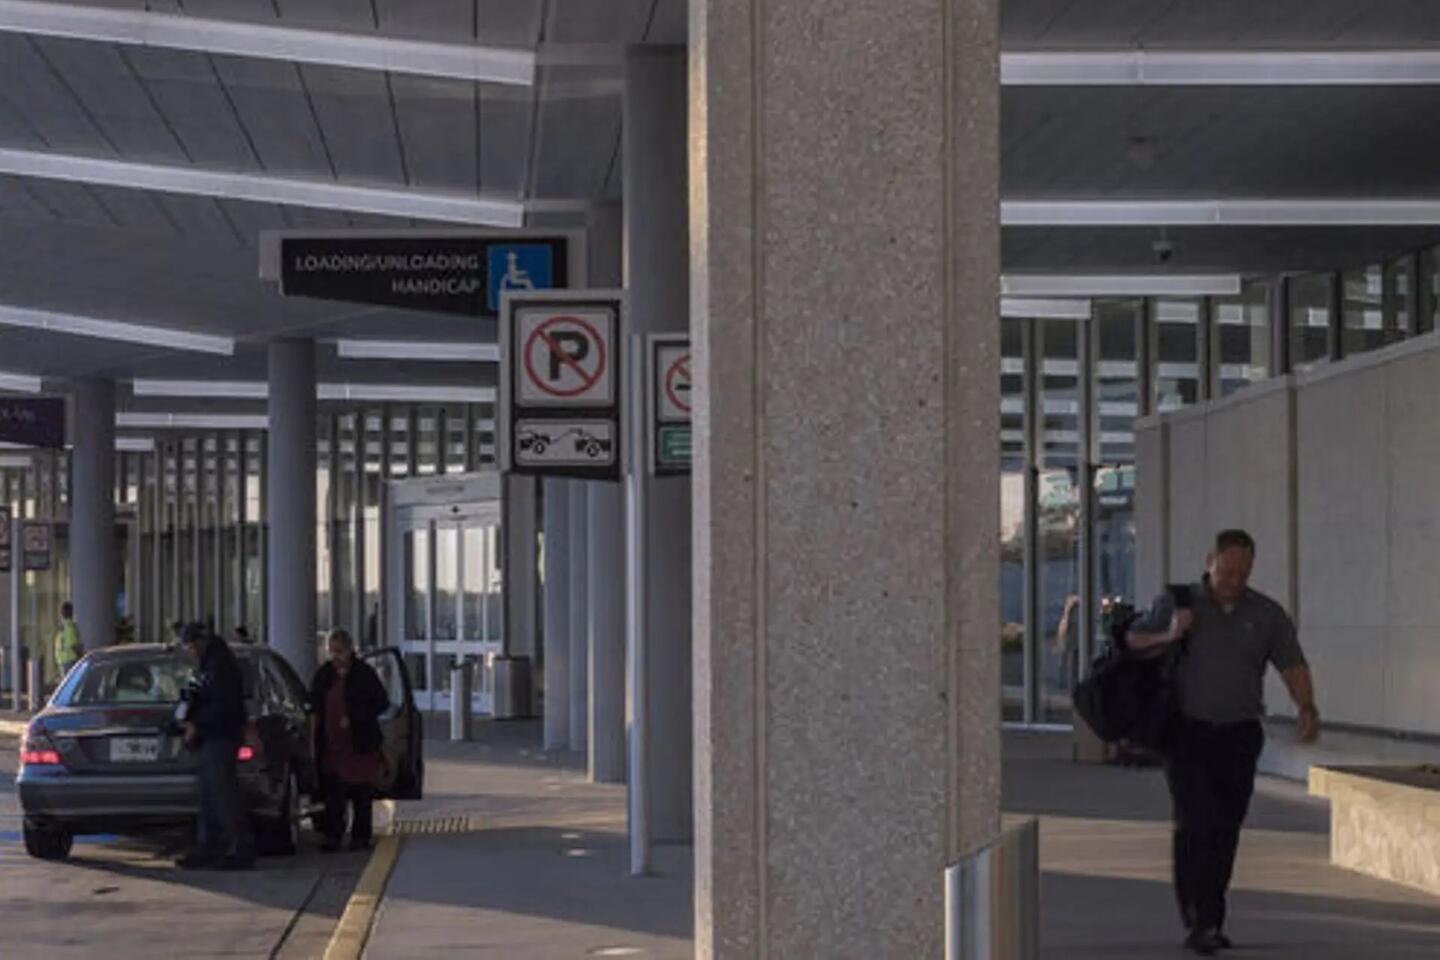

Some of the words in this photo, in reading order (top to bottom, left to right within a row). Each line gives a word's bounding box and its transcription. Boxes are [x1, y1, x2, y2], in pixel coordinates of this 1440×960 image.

[295, 254, 479, 271] LOADING/UNLOADING
[391, 279, 480, 294] HANDICAP
[549, 330, 589, 381] P
